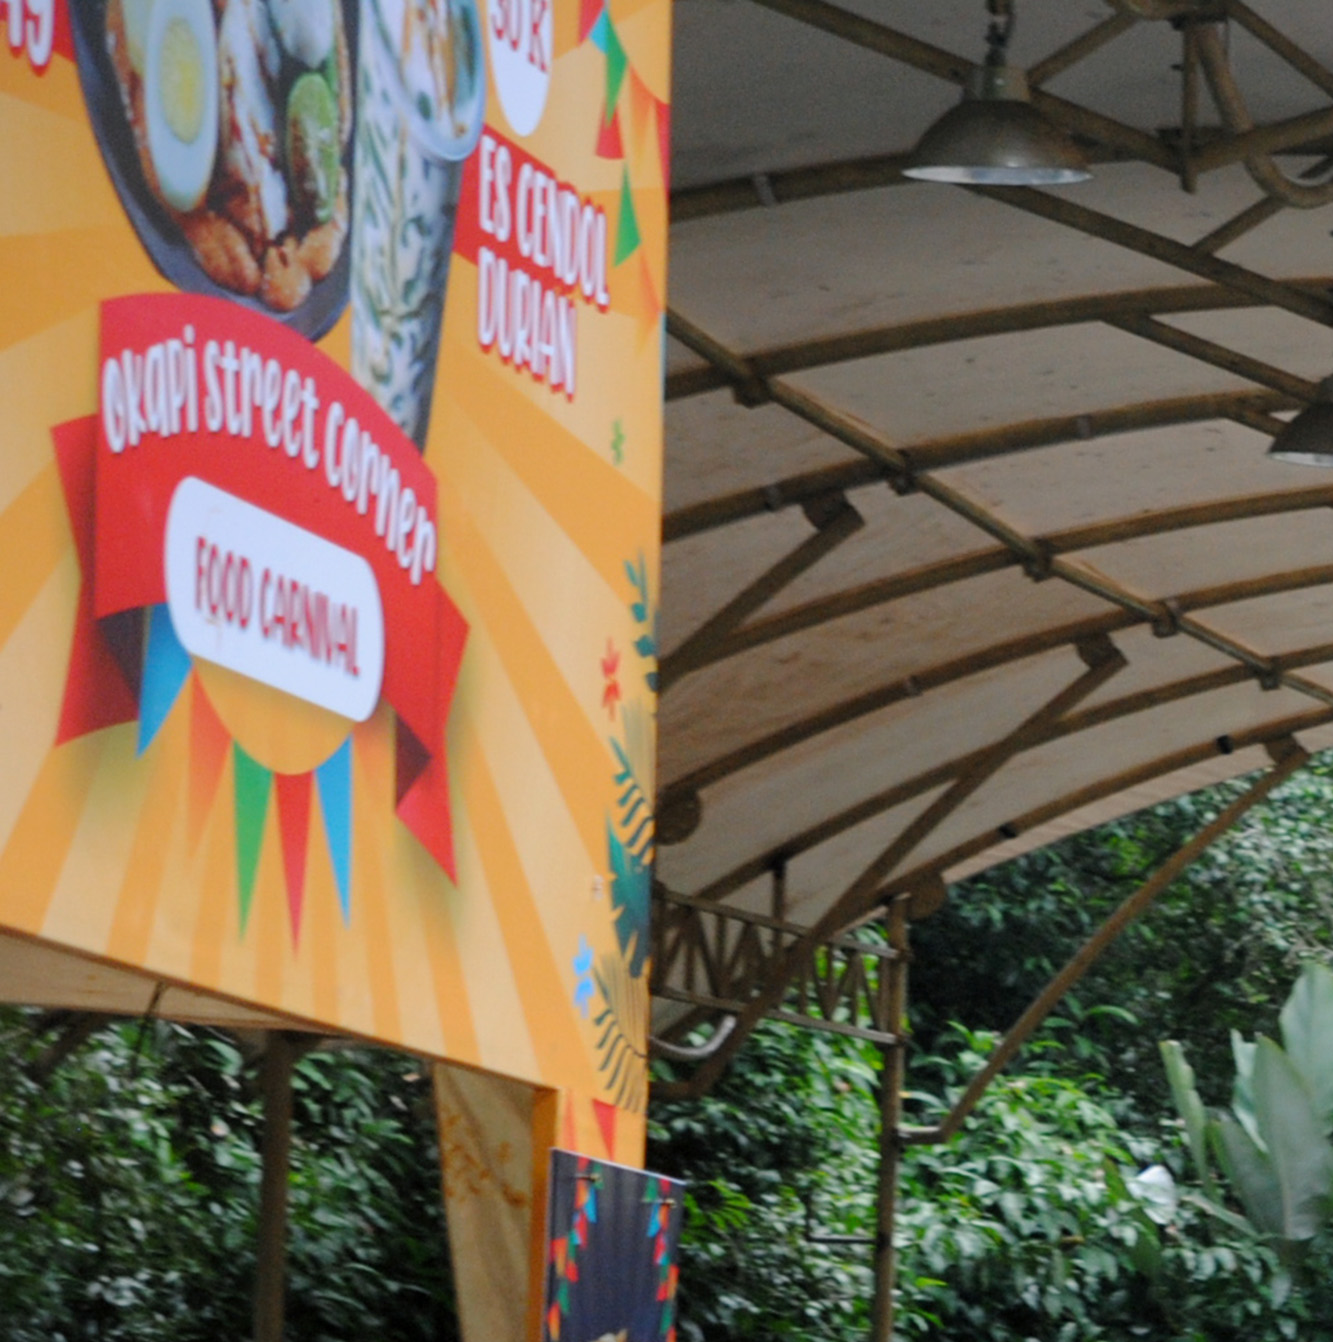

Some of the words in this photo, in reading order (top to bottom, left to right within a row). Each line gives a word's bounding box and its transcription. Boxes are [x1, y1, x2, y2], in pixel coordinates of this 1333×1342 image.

[479, 135, 513, 241] ES
[516, 161, 609, 306] CENDOL
[477, 248, 577, 396] DURIAN
[195, 537, 253, 630] FOOD
[258, 566, 361, 677] CARNIVAL
